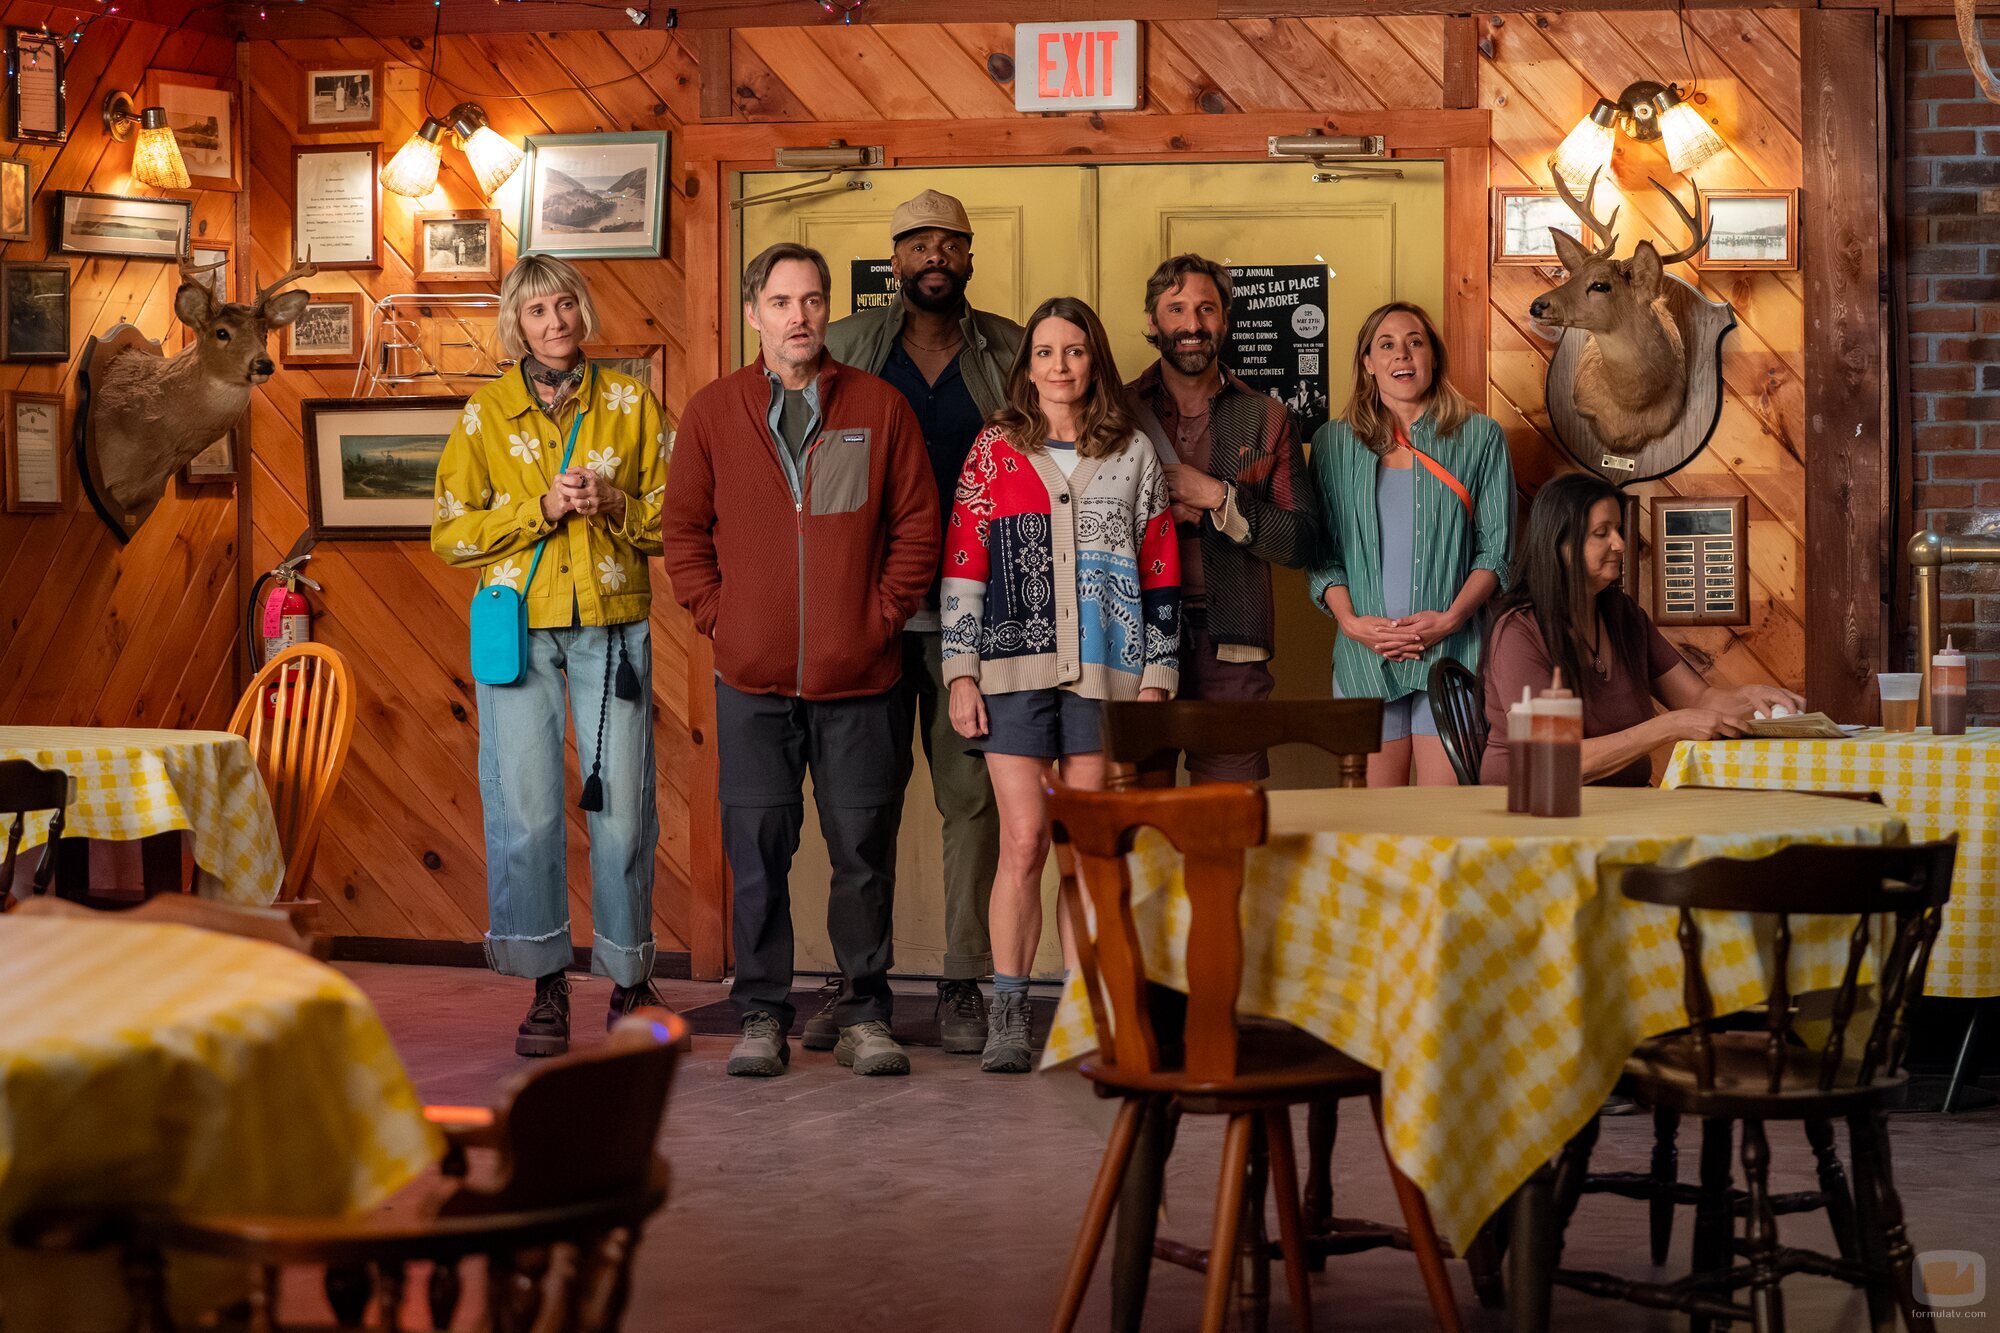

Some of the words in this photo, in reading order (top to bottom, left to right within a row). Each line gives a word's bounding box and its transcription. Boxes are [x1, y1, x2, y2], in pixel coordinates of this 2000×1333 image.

[1038, 31, 1118, 98] EXIT
[1246, 268, 1274, 277] ANNUAL
[1232, 283, 1265, 298] ONNA'S
[1268, 280, 1285, 293] EAT
[1288, 276, 1320, 291] PLACE
[1247, 293, 1300, 310] JAMBOREE
[1237, 320, 1251, 328] LIVE
[1252, 320, 1273, 328] MUSIC
[1232, 332, 1255, 340] STRONG
[1256, 332, 1278, 340] DRINKS
[1238, 344, 1256, 352] GREAT
[1243, 356, 1267, 364] RAFFLES
[1238, 368, 1258, 376] EATING
[1260, 368, 1285, 376] CONTEST
